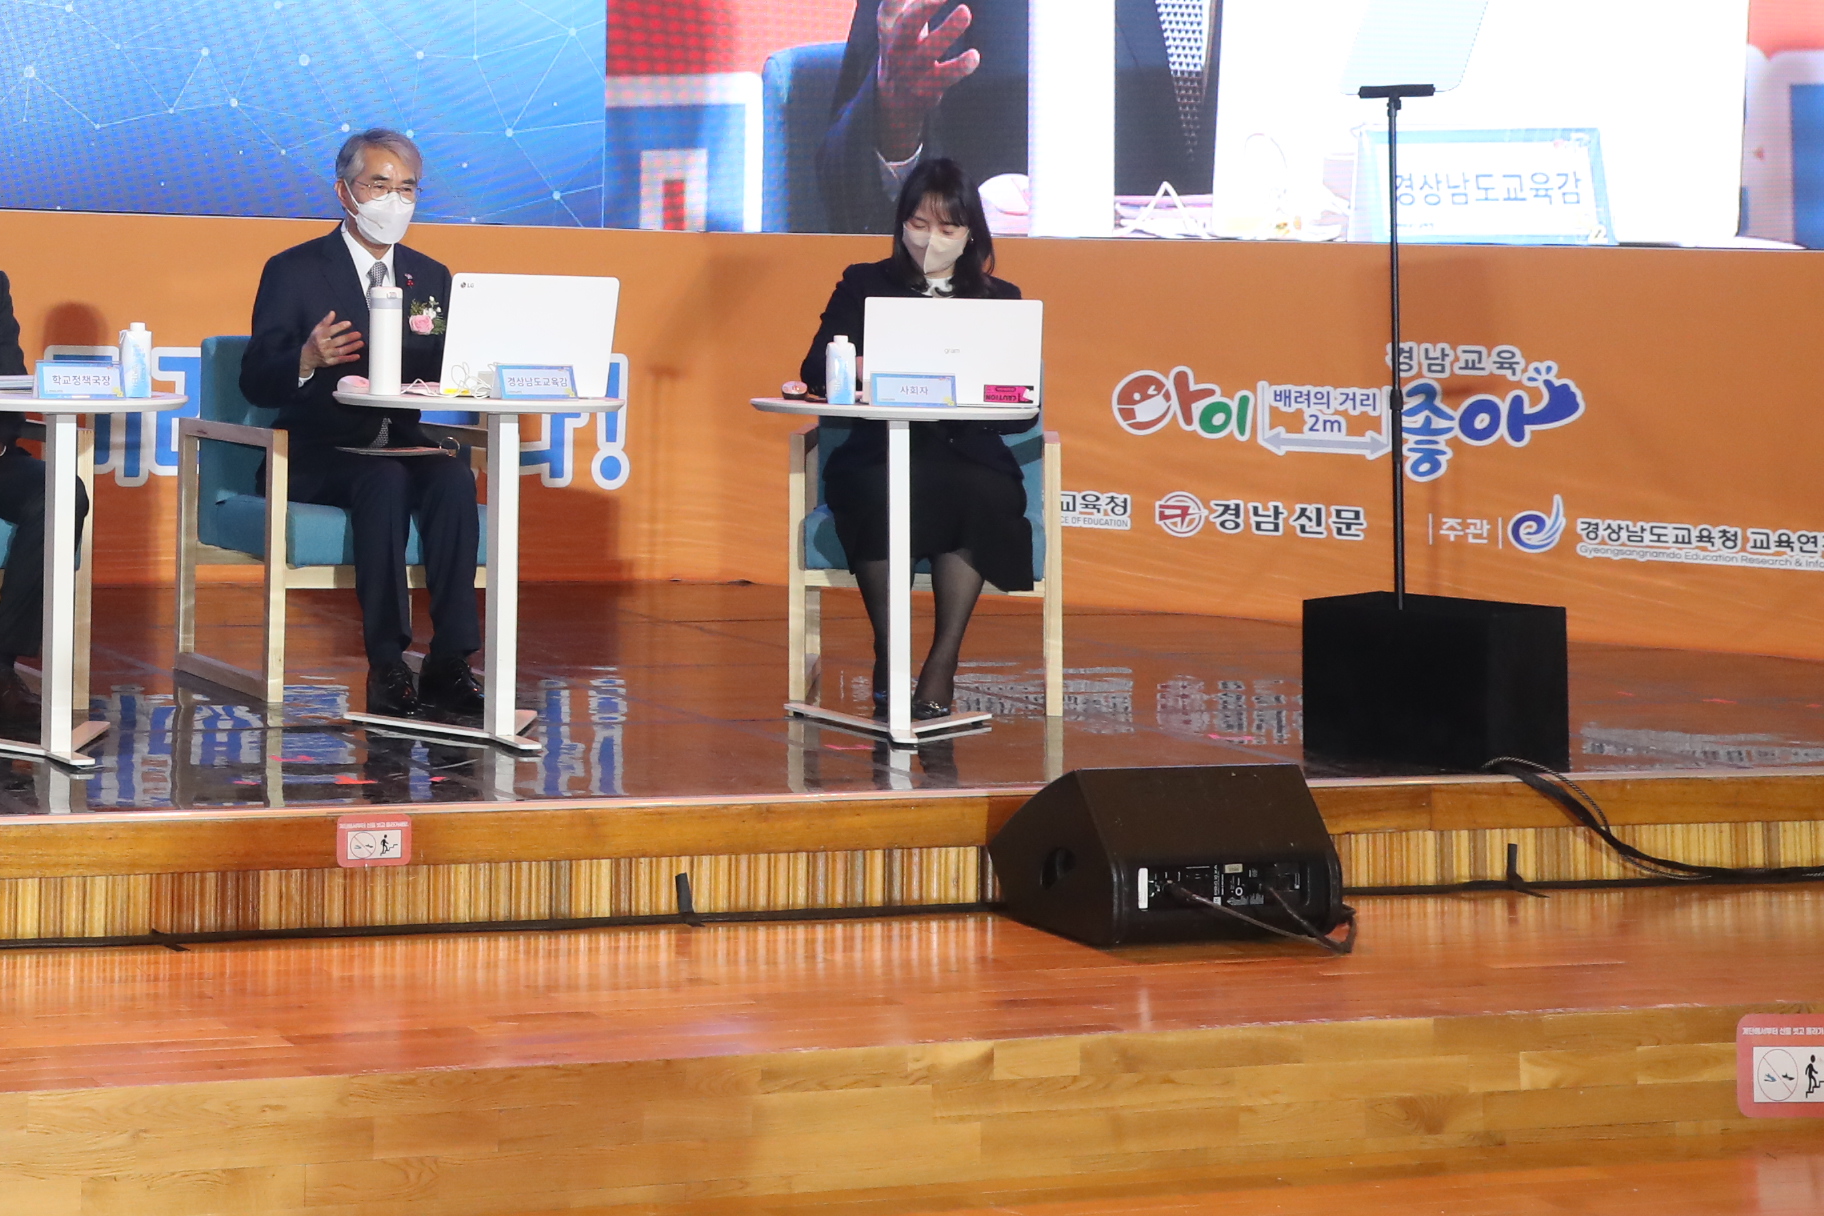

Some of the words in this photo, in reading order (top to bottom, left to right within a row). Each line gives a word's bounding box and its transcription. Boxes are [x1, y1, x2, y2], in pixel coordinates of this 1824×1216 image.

[1394, 170, 1582, 207] 경상남도교육감
[52, 374, 111, 386] 학교정책국장
[507, 376, 568, 387] 경상남도교육감
[900, 385, 929, 396] 사회자
[1273, 387, 1332, 410] 배려의
[1337, 390, 1377, 413] 거리
[1307, 412, 1343, 434] 2m
[1071, 517, 1082, 526] OF
[1082, 517, 1129, 528] EDUCATION
[1212, 501, 1365, 538] 경남신문
[1439, 516, 1491, 545] 주관
[1579, 520, 1739, 551] 경상남도교육청
[1749, 530, 1824, 555] 교육연
[1579, 544, 1683, 562] Gyeongsangnamdo
[1684, 551, 1738, 564] Education
[1741, 555, 1793, 567] Research
